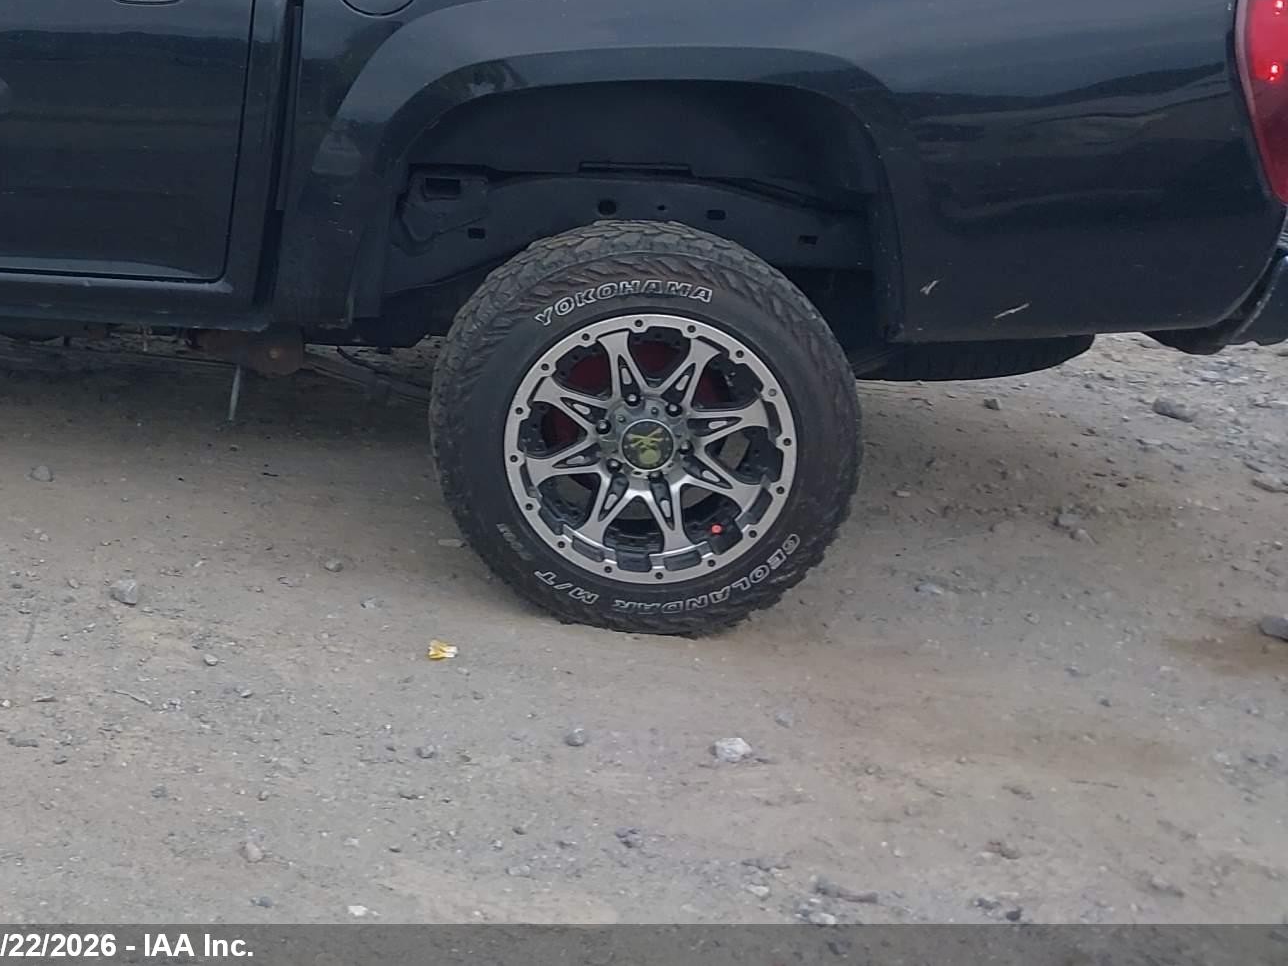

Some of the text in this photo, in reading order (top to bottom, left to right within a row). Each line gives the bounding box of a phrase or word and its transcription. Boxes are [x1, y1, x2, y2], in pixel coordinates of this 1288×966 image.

[534, 279, 713, 326] YOKOHAMA
[533, 532, 801, 615] GEOLANDAR M/T
